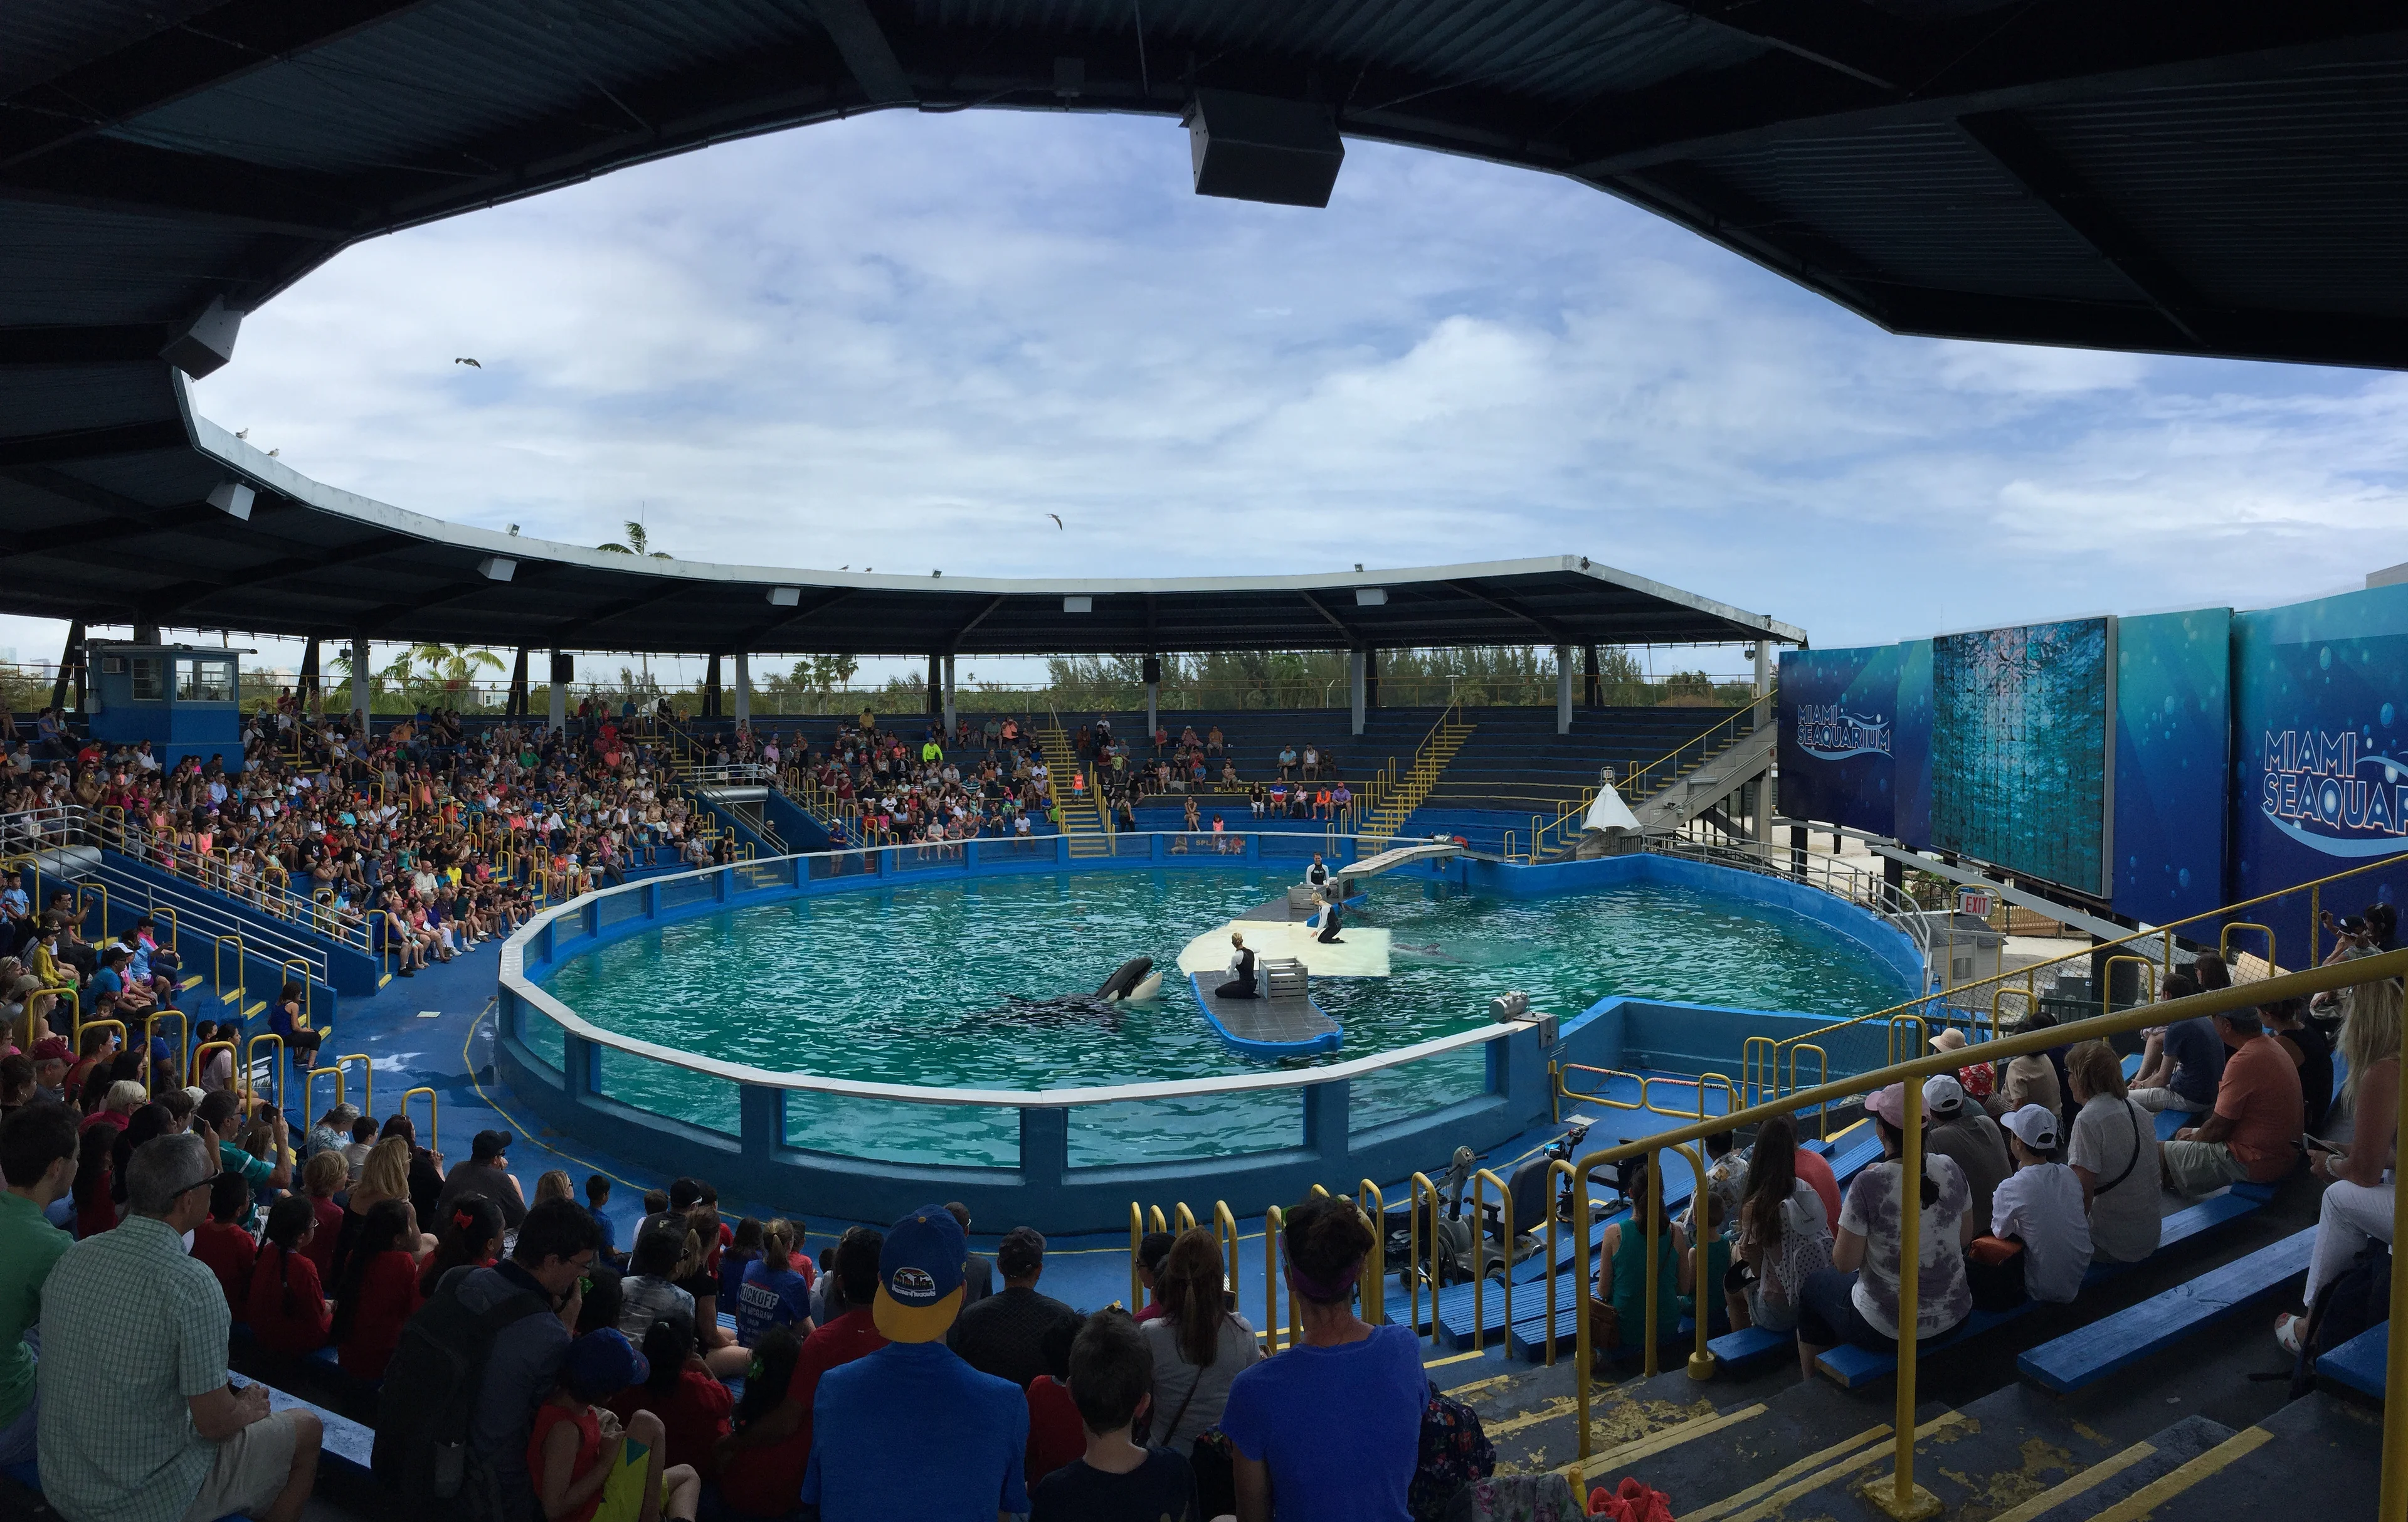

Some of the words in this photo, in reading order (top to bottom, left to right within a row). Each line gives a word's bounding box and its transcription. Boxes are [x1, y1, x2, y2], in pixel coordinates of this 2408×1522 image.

[1797, 704, 1837, 726] MIAMI
[1797, 724, 1891, 751] SEAQUARIUM
[2264, 731, 2356, 778] MIAMI
[1965, 896, 1987, 914] EXIT
[740, 1284, 779, 1309] KICKOFF
